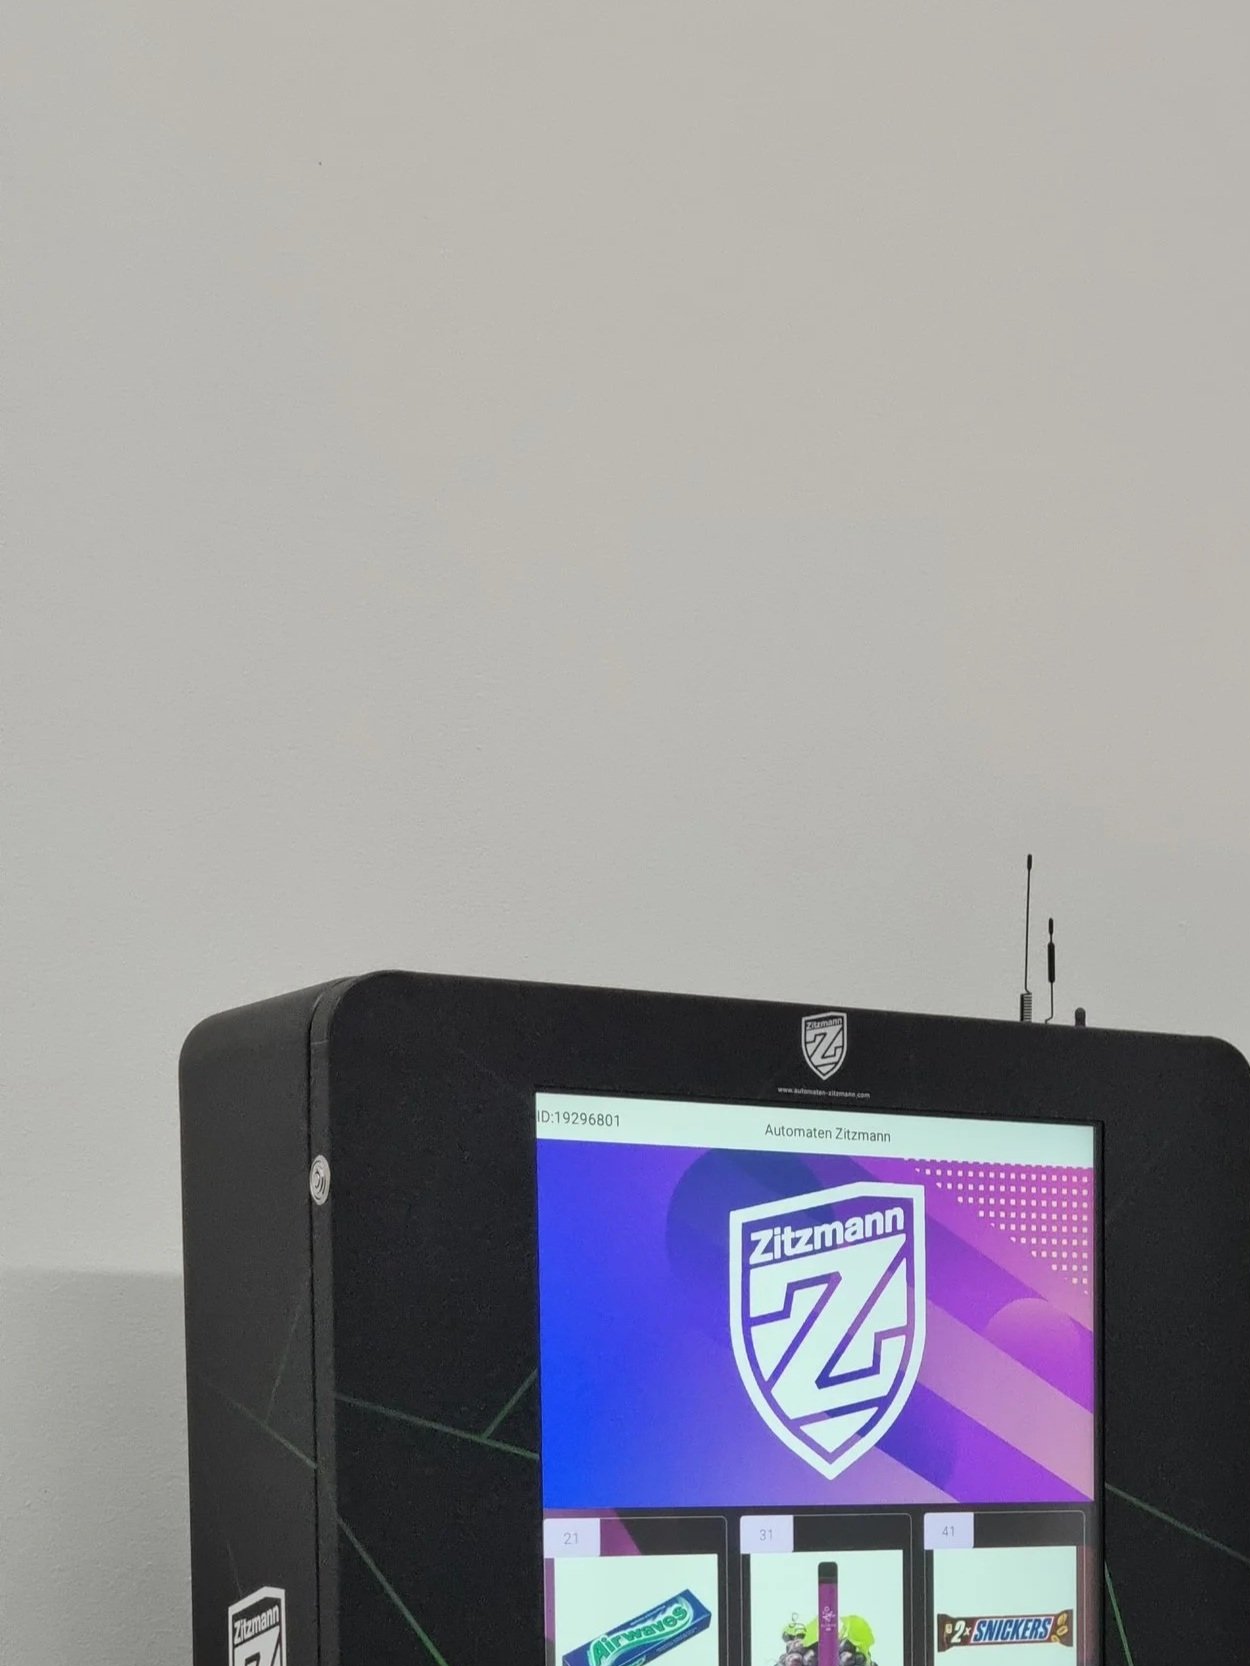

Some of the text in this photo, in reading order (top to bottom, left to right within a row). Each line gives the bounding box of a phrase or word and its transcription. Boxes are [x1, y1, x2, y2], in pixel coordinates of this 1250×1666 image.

[805, 1018, 843, 1030] Zitzmann
[777, 1087, 871, 1099] www.automaten-zitzmann.com
[537, 1109, 621, 1128] ID:19296801
[764, 1123, 892, 1143] Automaten Zitzmann
[748, 1206, 905, 1265] Zitzmann
[563, 1532, 579, 1545] 21
[759, 1529, 773, 1541] 31
[942, 1525, 956, 1538] 41
[233, 1605, 280, 1645] Zitzmann
[973, 1617, 1052, 1642] SNICKERS
